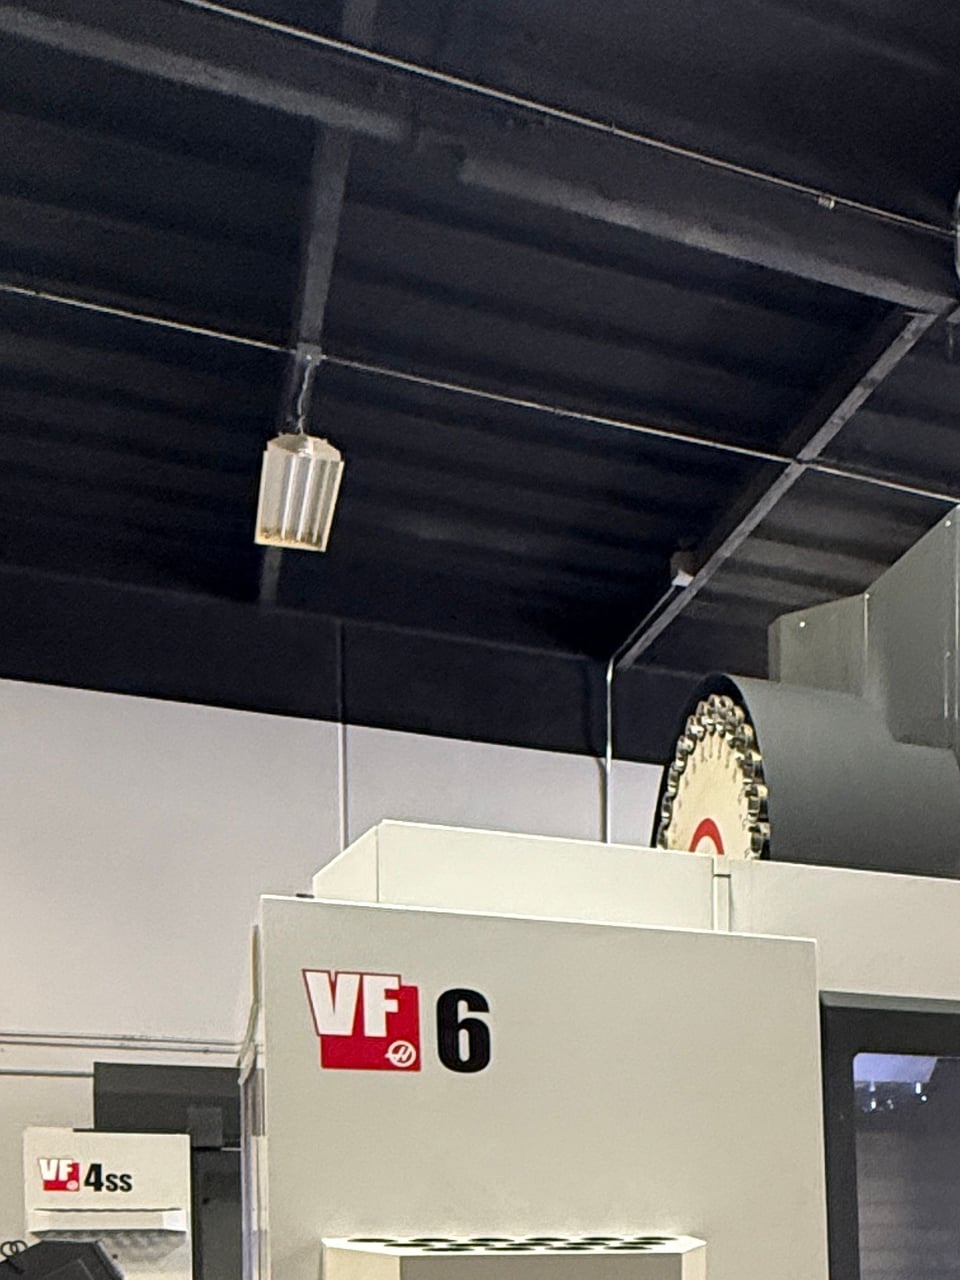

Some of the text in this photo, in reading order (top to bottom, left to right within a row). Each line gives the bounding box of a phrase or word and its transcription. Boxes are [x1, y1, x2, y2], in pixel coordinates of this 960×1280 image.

[302, 968, 491, 1074] VF 6
[37, 1158, 75, 1182] VF
